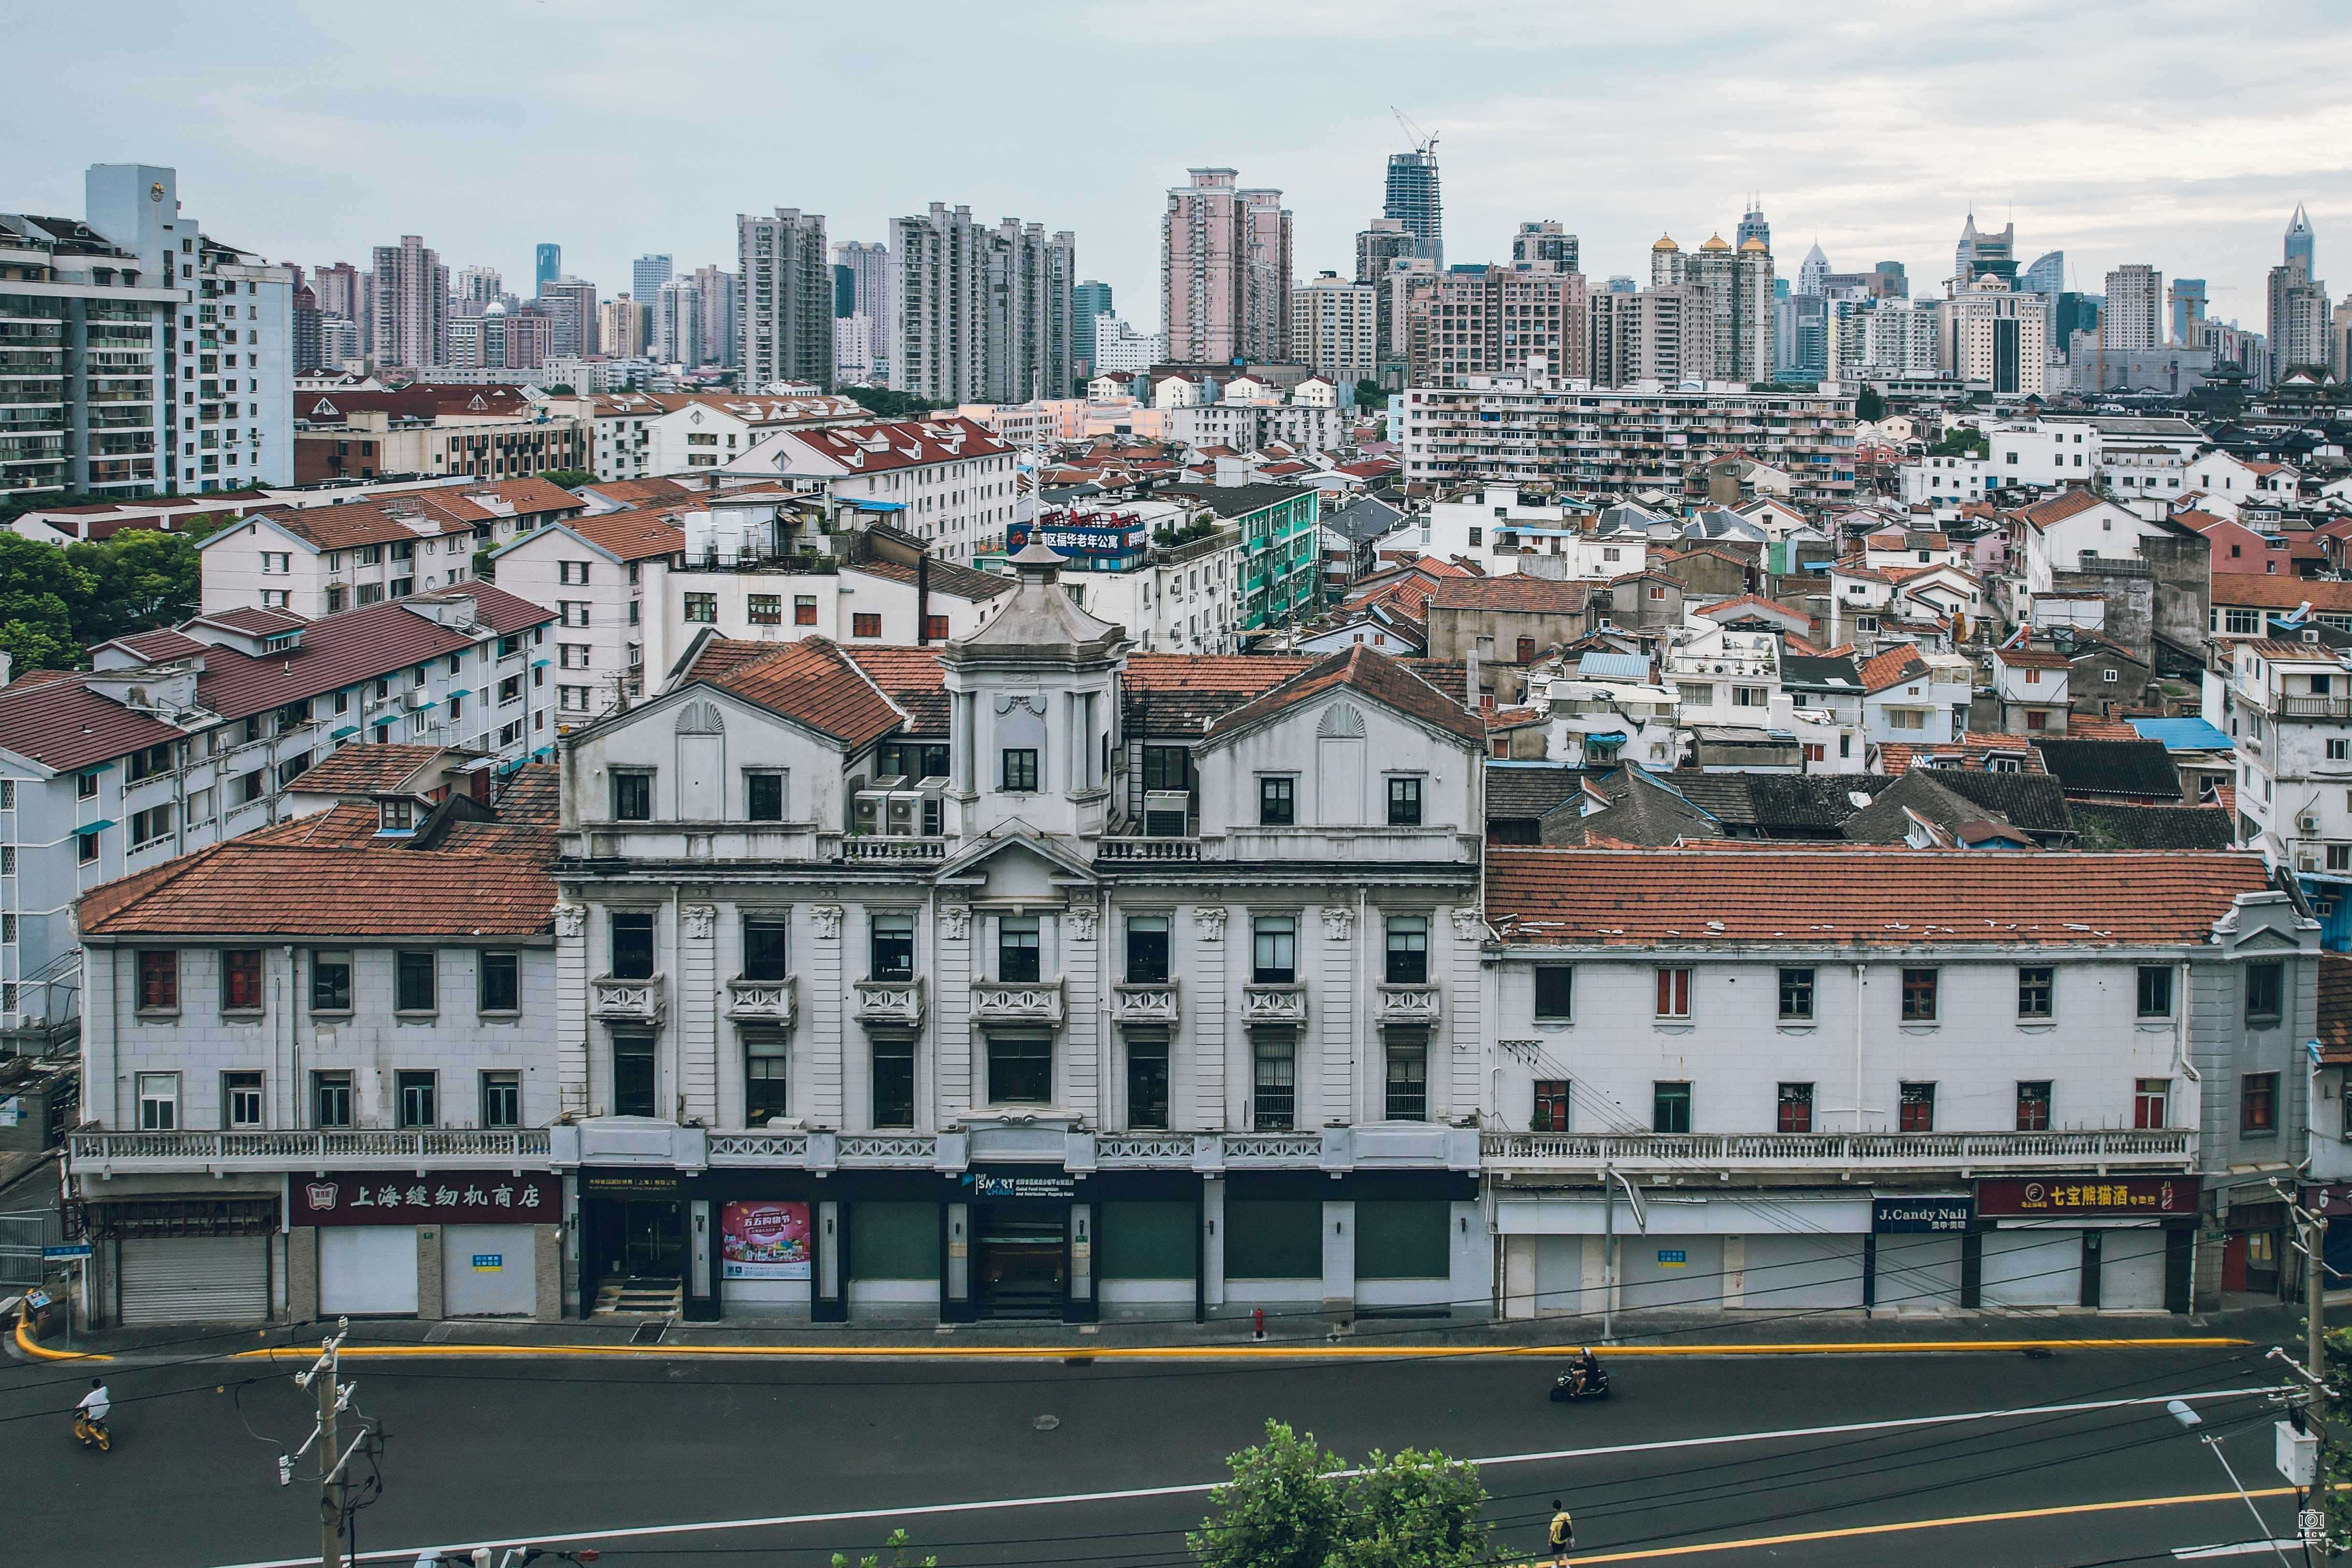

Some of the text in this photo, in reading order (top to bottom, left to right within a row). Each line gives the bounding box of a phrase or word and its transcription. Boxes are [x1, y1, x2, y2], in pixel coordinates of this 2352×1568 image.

[978, 1178, 1014, 1189] SMART
[350, 1184, 541, 1208] 上海缝纫机商店
[2050, 1185, 2128, 1206] 七宝熊猫酒
[744, 1215, 790, 1226] 五五购物节
[1879, 1208, 1967, 1222] J.Candy Nail
